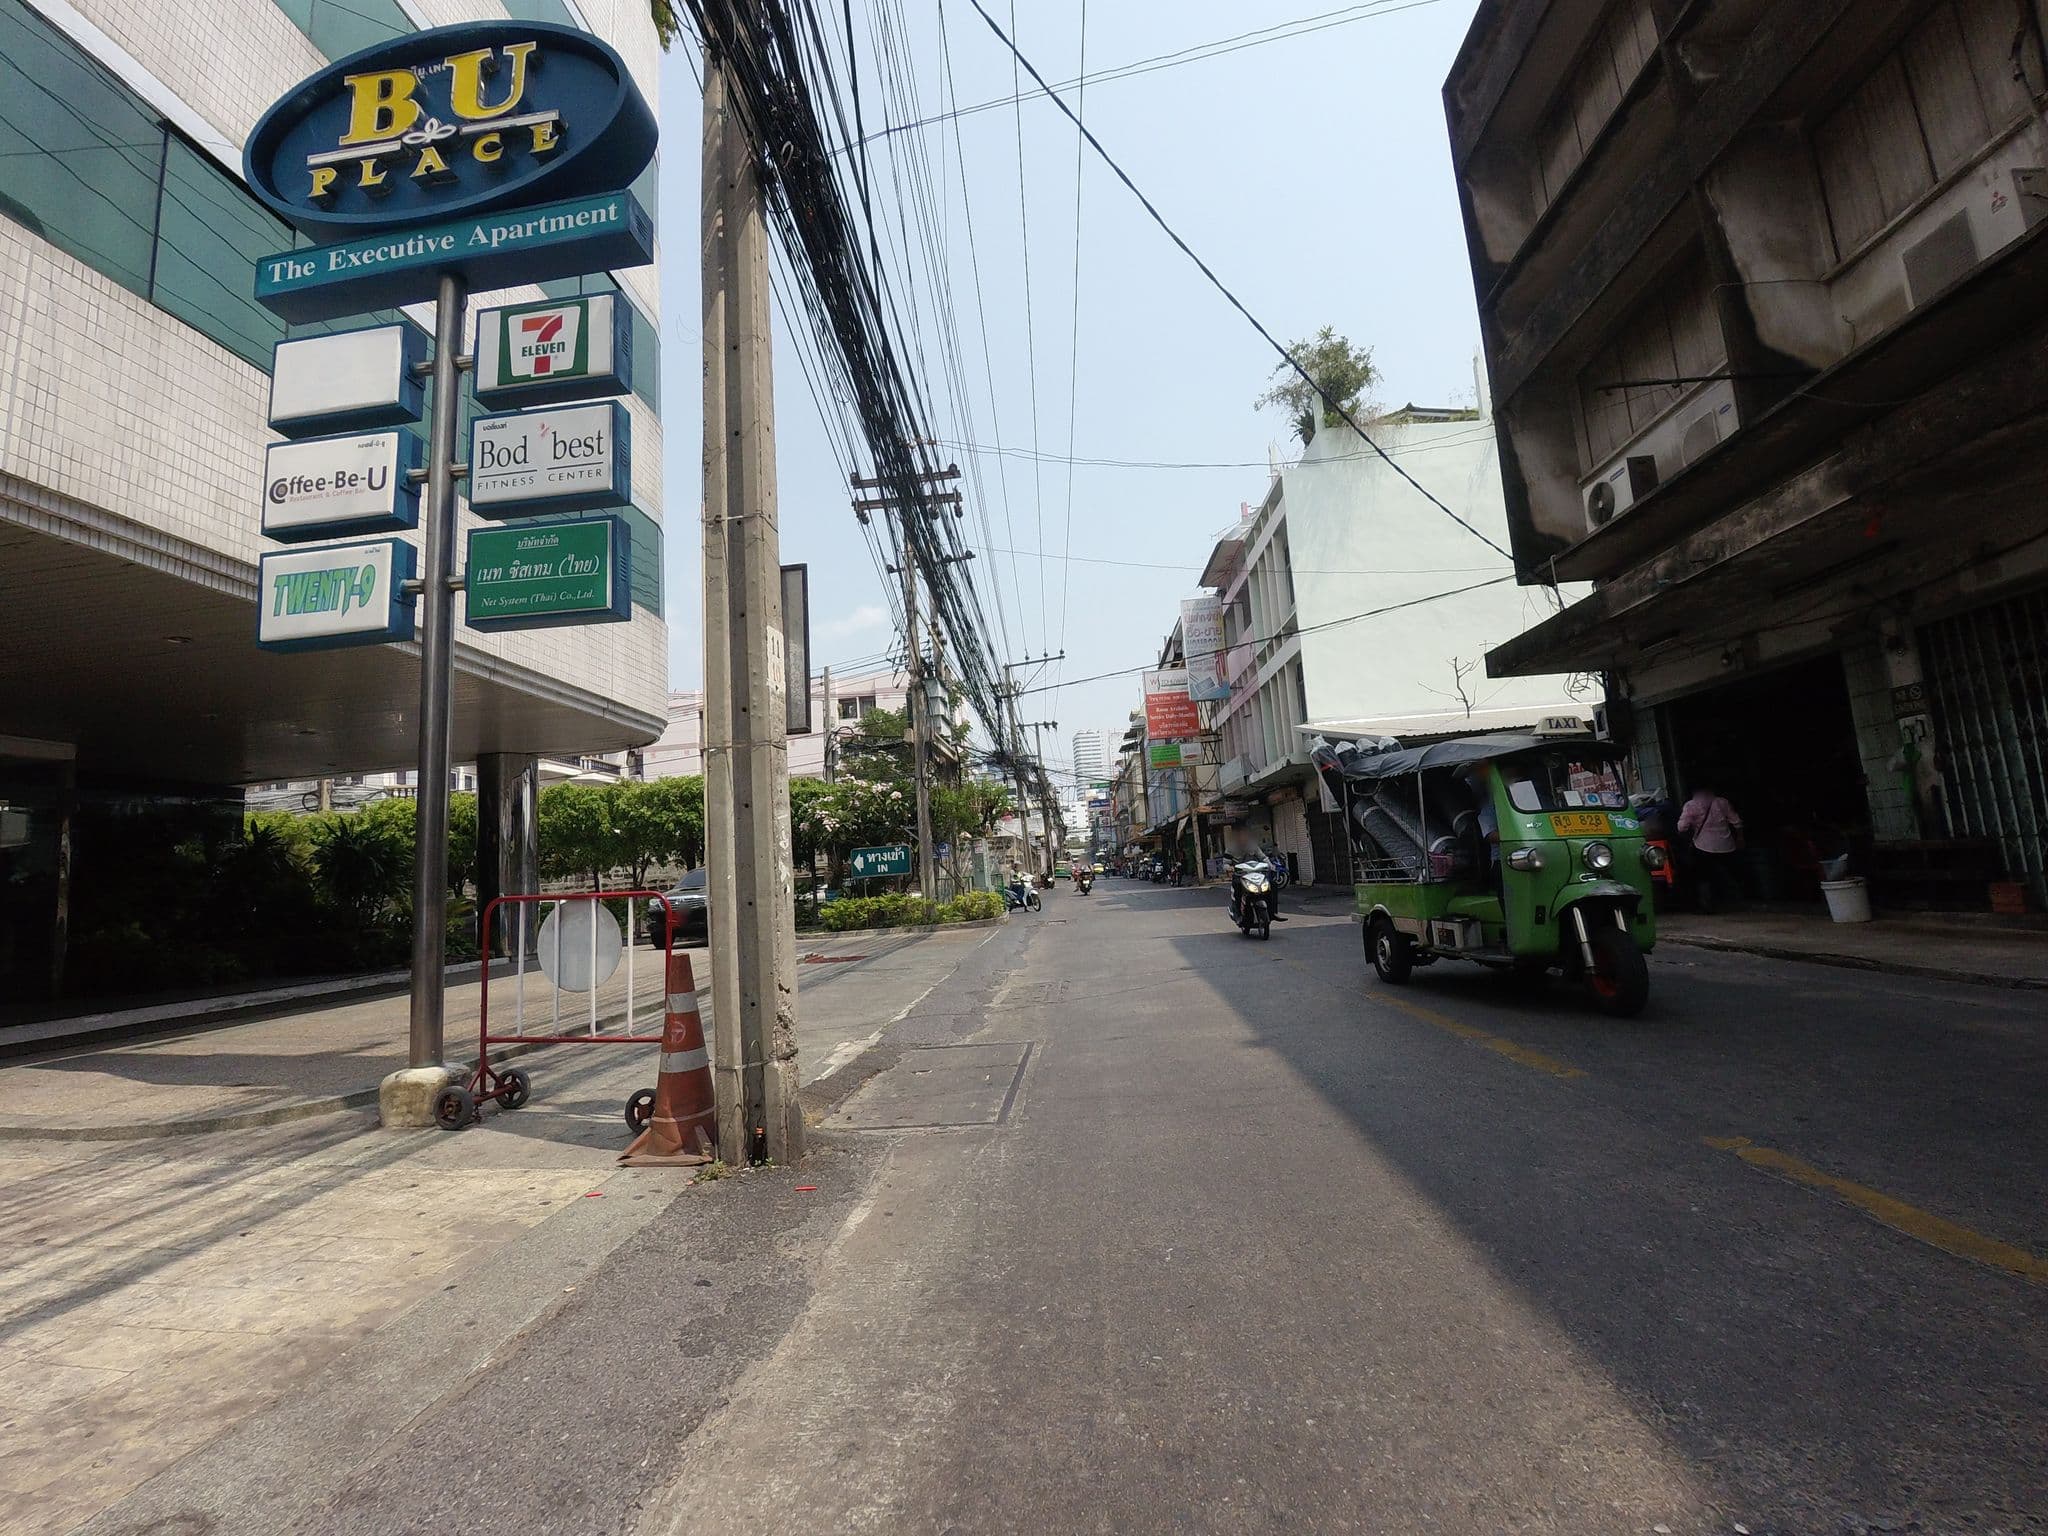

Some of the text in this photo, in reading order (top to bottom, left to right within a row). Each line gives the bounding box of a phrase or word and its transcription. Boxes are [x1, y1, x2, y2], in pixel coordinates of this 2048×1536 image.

[307, 123, 559, 198] PLACE
[269, 202, 619, 283] The Executive Apartment
[552, 429, 604, 461] best
[269, 465, 387, 504] Coffee-Be-U
[477, 469, 603, 491] FITNESS CENTER
[558, 553, 600, 577] (ไทย)
[273, 563, 376, 618] TWENTY-9
[481, 597, 497, 607] Net
[499, 595, 528, 607] System
[530, 592, 557, 604] (Thai)
[1546, 717, 1577, 729] TAXI
[1579, 814, 1603, 826] 828
[866, 847, 905, 863] ทางเข้า
[877, 864, 889, 873] IN
